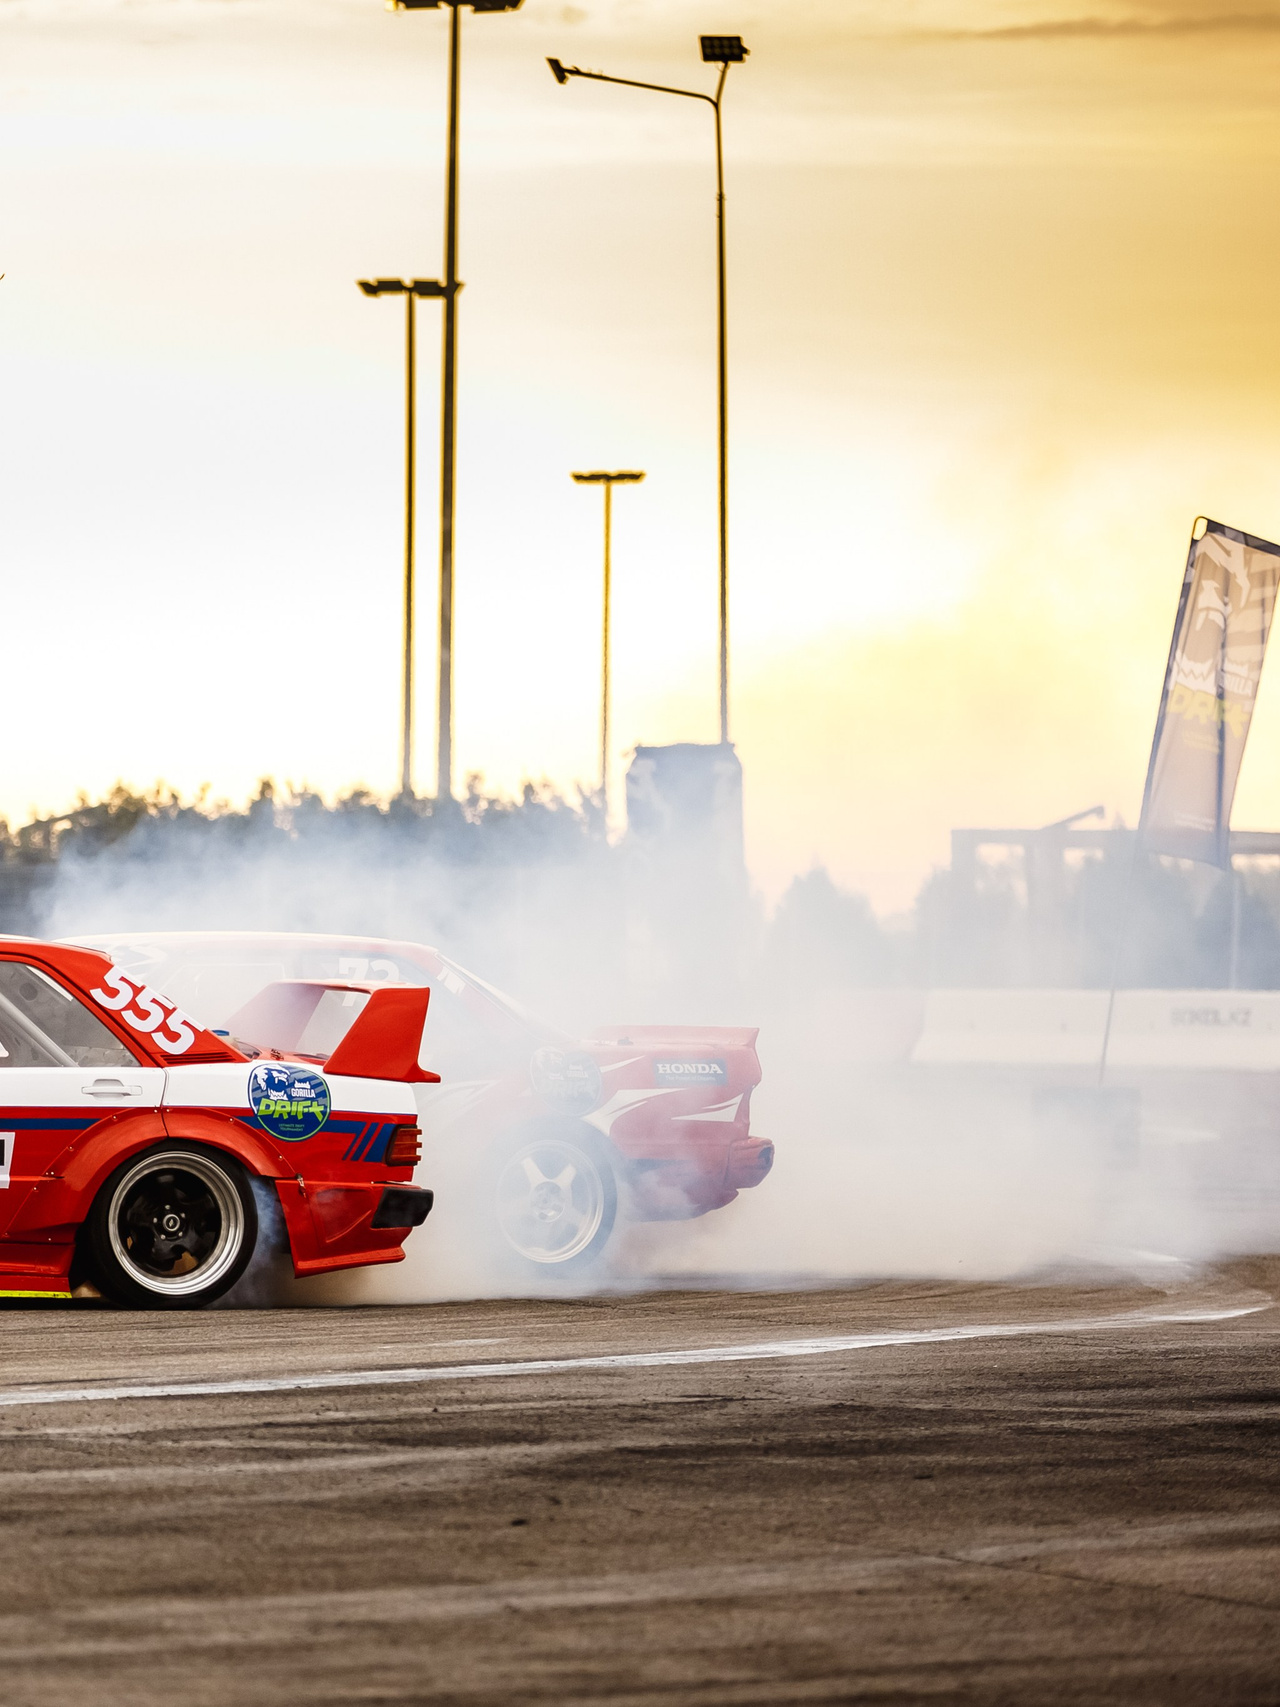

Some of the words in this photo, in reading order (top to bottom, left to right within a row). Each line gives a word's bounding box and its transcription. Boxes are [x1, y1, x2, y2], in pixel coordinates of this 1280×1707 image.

[89, 965, 207, 1055] 555
[656, 1063, 724, 1074] HONDA
[291, 1088, 316, 1098] GORILLA
[257, 1097, 325, 1122] DRIFT
